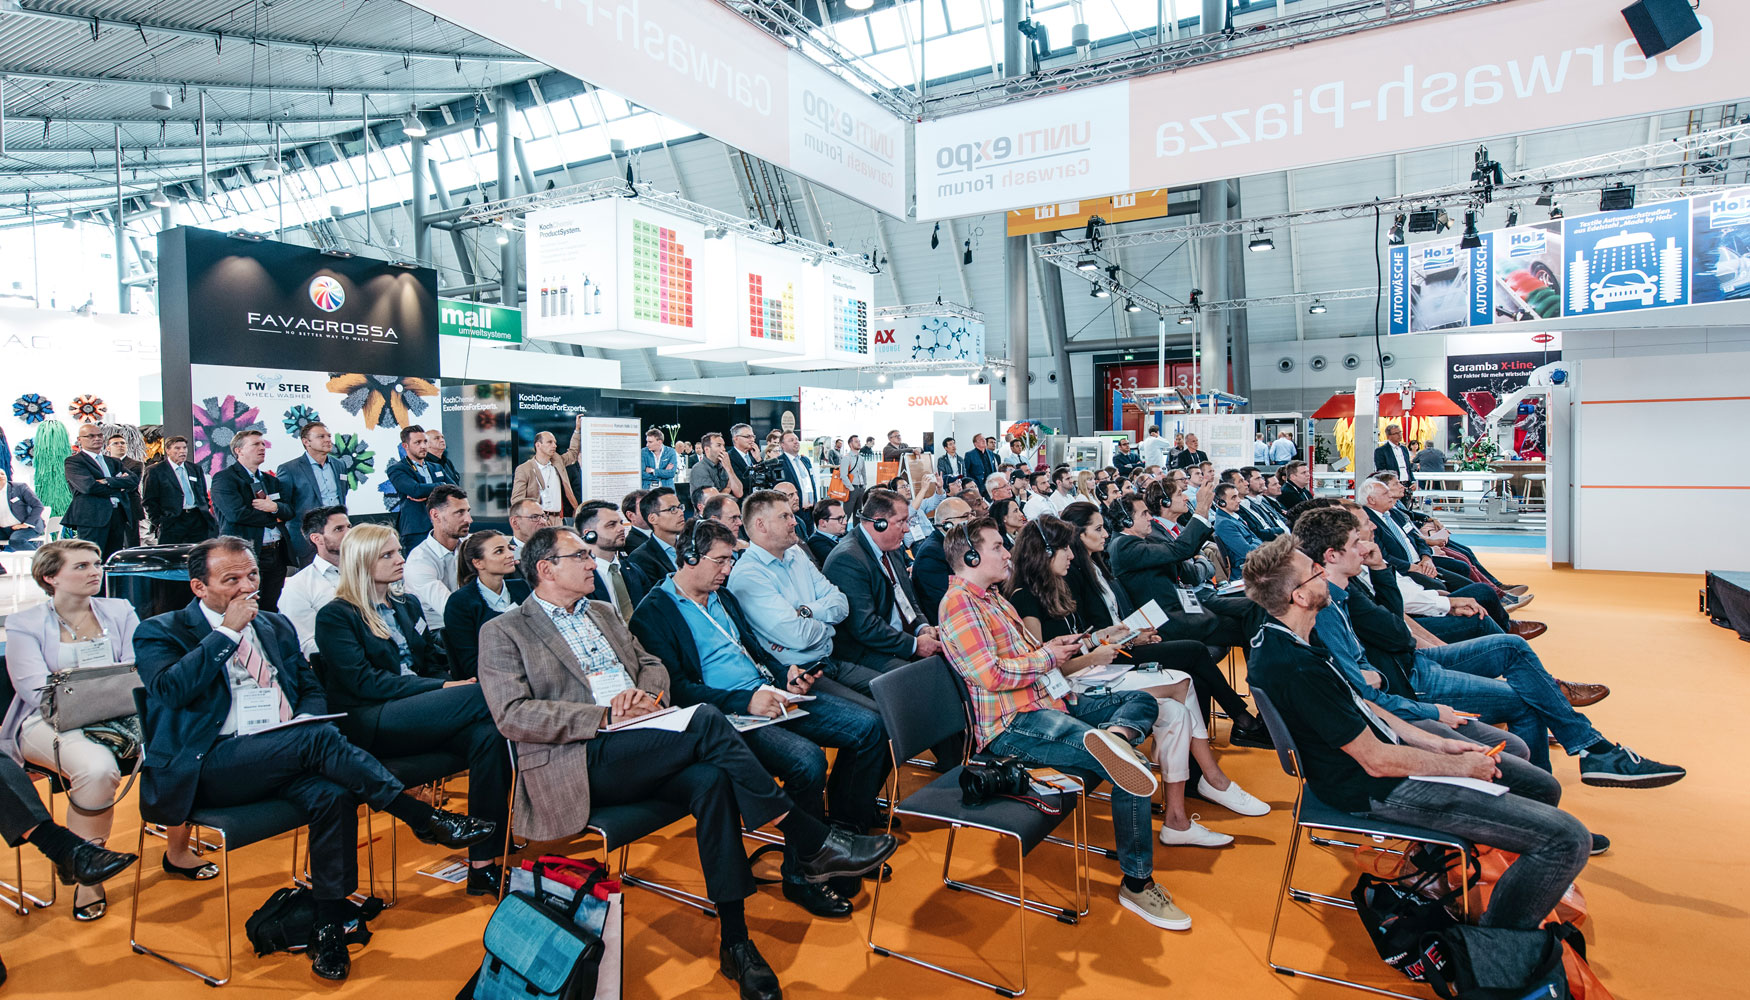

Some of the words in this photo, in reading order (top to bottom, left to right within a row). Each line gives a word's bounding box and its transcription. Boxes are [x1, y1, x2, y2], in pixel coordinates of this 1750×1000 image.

[1580, 218, 1602, 228] Textile
[1603, 207, 1671, 224] Autowaschstraßen
[1587, 222, 1619, 233] Edelstahl
[1645, 217, 1655, 225] by
[1511, 232, 1545, 245] Holz
[1424, 247, 1453, 259] Holz
[1392, 252, 1404, 324] AUTOWÄSCHE
[441, 307, 492, 329] mall
[247, 312, 399, 339] FAVAGROSSA
[458, 327, 512, 340] umweltsysteme
[1453, 362, 1498, 373] Caramba
[1501, 361, 1537, 370] X-Line.
[519, 402, 587, 412] ExcellenceForExperts.
[908, 395, 948, 407] SONAX
